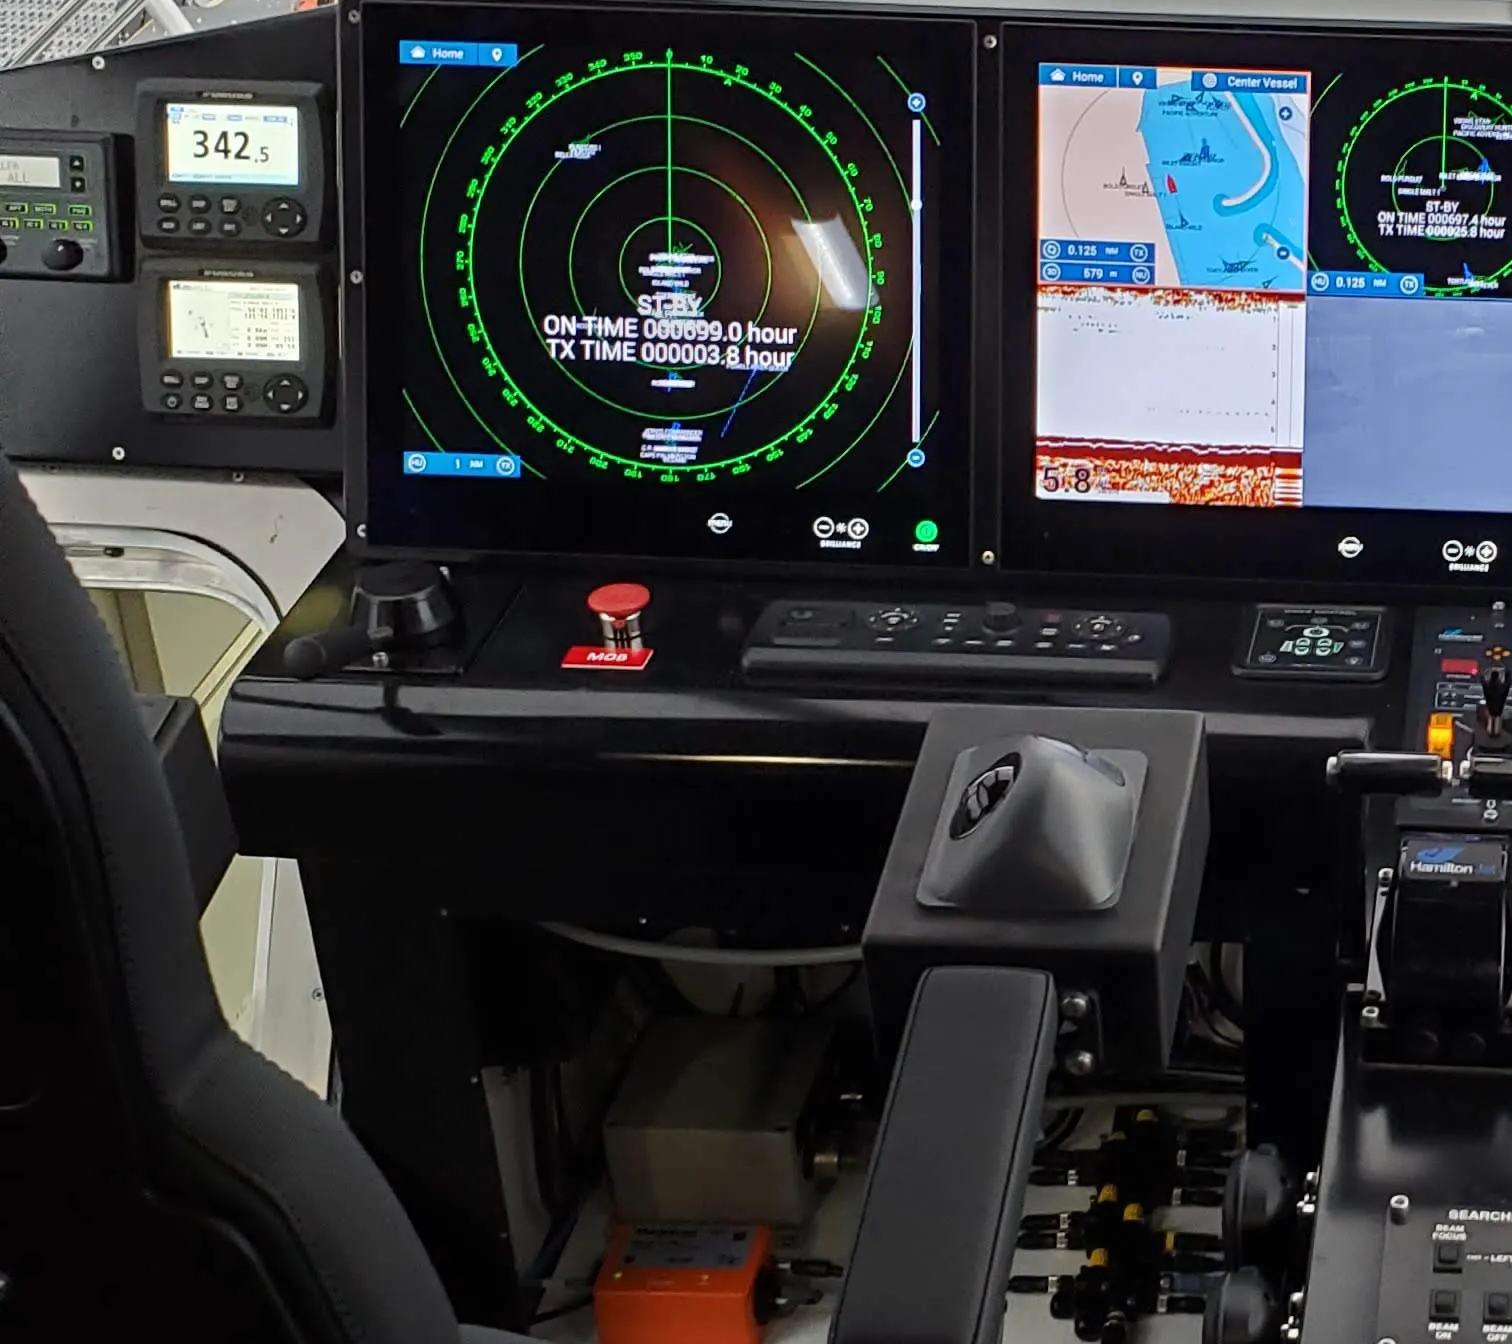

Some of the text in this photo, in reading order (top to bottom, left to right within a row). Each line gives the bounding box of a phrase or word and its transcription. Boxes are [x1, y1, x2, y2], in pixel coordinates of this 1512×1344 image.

[432, 48, 464, 59] Home
[1072, 72, 1104, 83] Home
[1228, 76, 1298, 89] Center Vessel
[1425, 201, 1460, 213] ST-BY
[1377, 213, 1396, 224] ON
[1398, 213, 1426, 225] TIME
[1481, 216, 1506, 227] hour
[1377, 224, 1394, 235] TX
[1396, 225, 1424, 236] TIME
[1479, 227, 1505, 239] hour
[1068, 245, 1097, 256] 0.125
[1336, 277, 1365, 288] 0.125
[543, 314, 577, 336] ON
[582, 316, 639, 338] TIME
[747, 321, 798, 345] hour
[546, 339, 576, 361] TX
[580, 339, 637, 362] TIME
[641, 343, 739, 366] 000003.8
[745, 345, 795, 367] hour
[1043, 467, 1091, 494] 5.8
[587, 652, 628, 662] MOB
[1435, 1224, 1465, 1232] BEAM
[1432, 1232, 1467, 1241] FOCUS
[1428, 1322, 1459, 1332] BEAM
[1482, 1324, 1512, 1333] BEAM
[1435, 1331, 1452, 1340] ON
[1486, 1333, 1508, 1342] OFF
